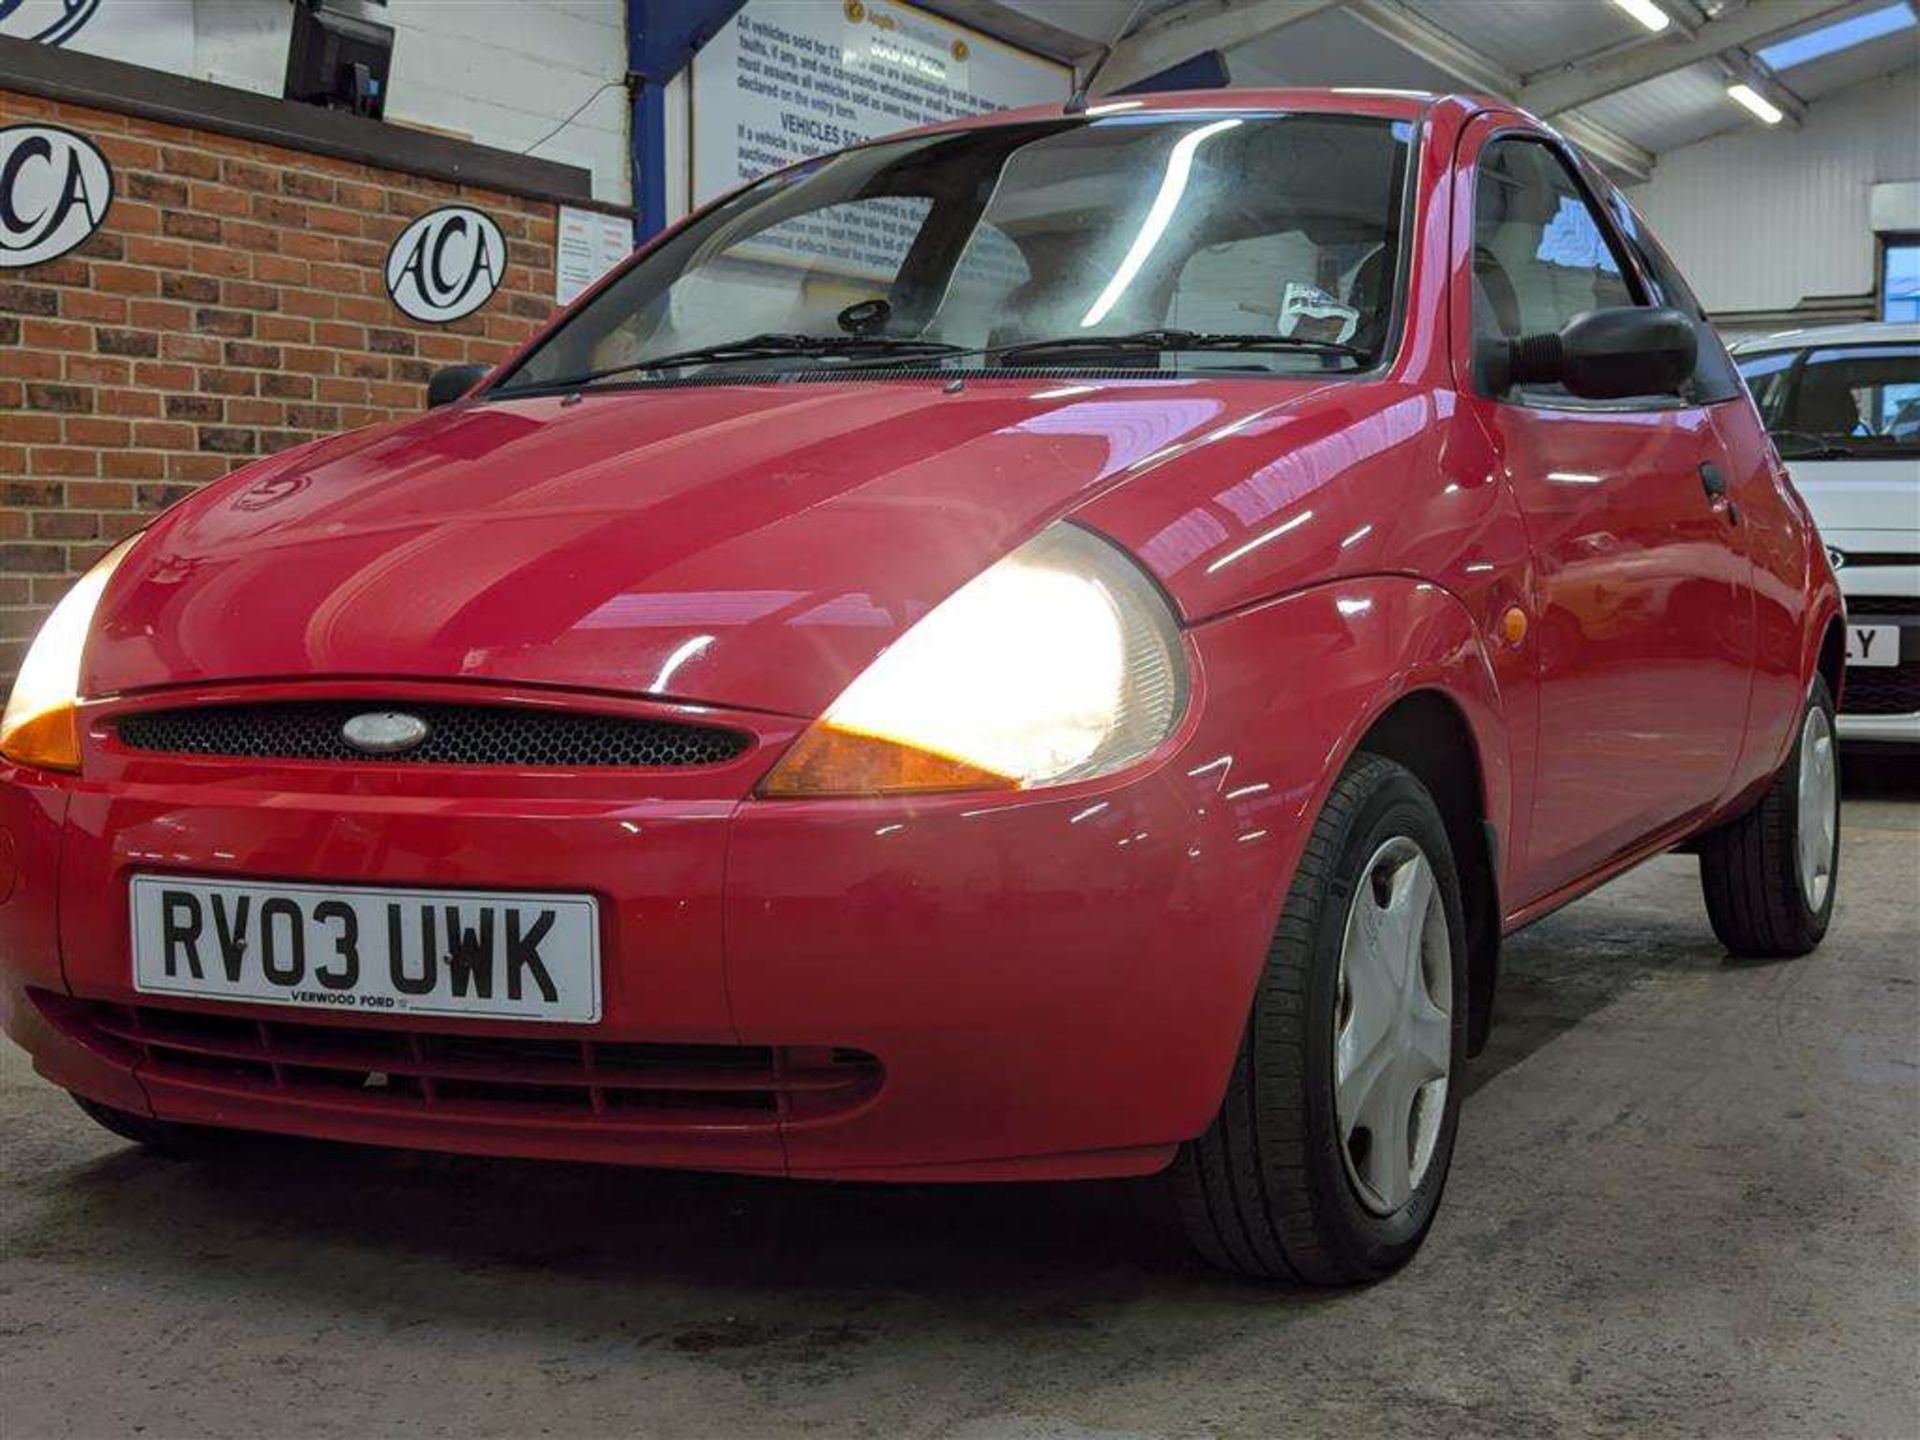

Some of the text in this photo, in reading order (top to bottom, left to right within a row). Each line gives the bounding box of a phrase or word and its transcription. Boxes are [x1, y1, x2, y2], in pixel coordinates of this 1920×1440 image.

[737, 14, 749, 29] All
[751, 22, 790, 44] vehicles
[792, 35, 812, 51] sold
[813, 41, 826, 55] for
[737, 56, 761, 73] must
[763, 64, 799, 86] assume
[801, 75, 813, 90] all
[814, 80, 850, 101] vehicles
[852, 92, 869, 107] sold
[871, 99, 881, 111] as
[882, 102, 901, 117] seen
[737, 75, 779, 98] declared
[780, 89, 793, 101] on
[794, 91, 808, 108] the
[811, 98, 834, 118] entry
[800, 56, 818, 73] and
[819, 63, 831, 76] no
[833, 67, 878, 92] complaints
[879, 83, 924, 106] whatsoever
[754, 131, 787, 150] vehicle
[780, 111, 841, 145] VEHICLES
[391, 215, 496, 308] ACA
[162, 890, 559, 1003] RV03 UWK
[291, 990, 395, 1008] VERWOOD FORD
